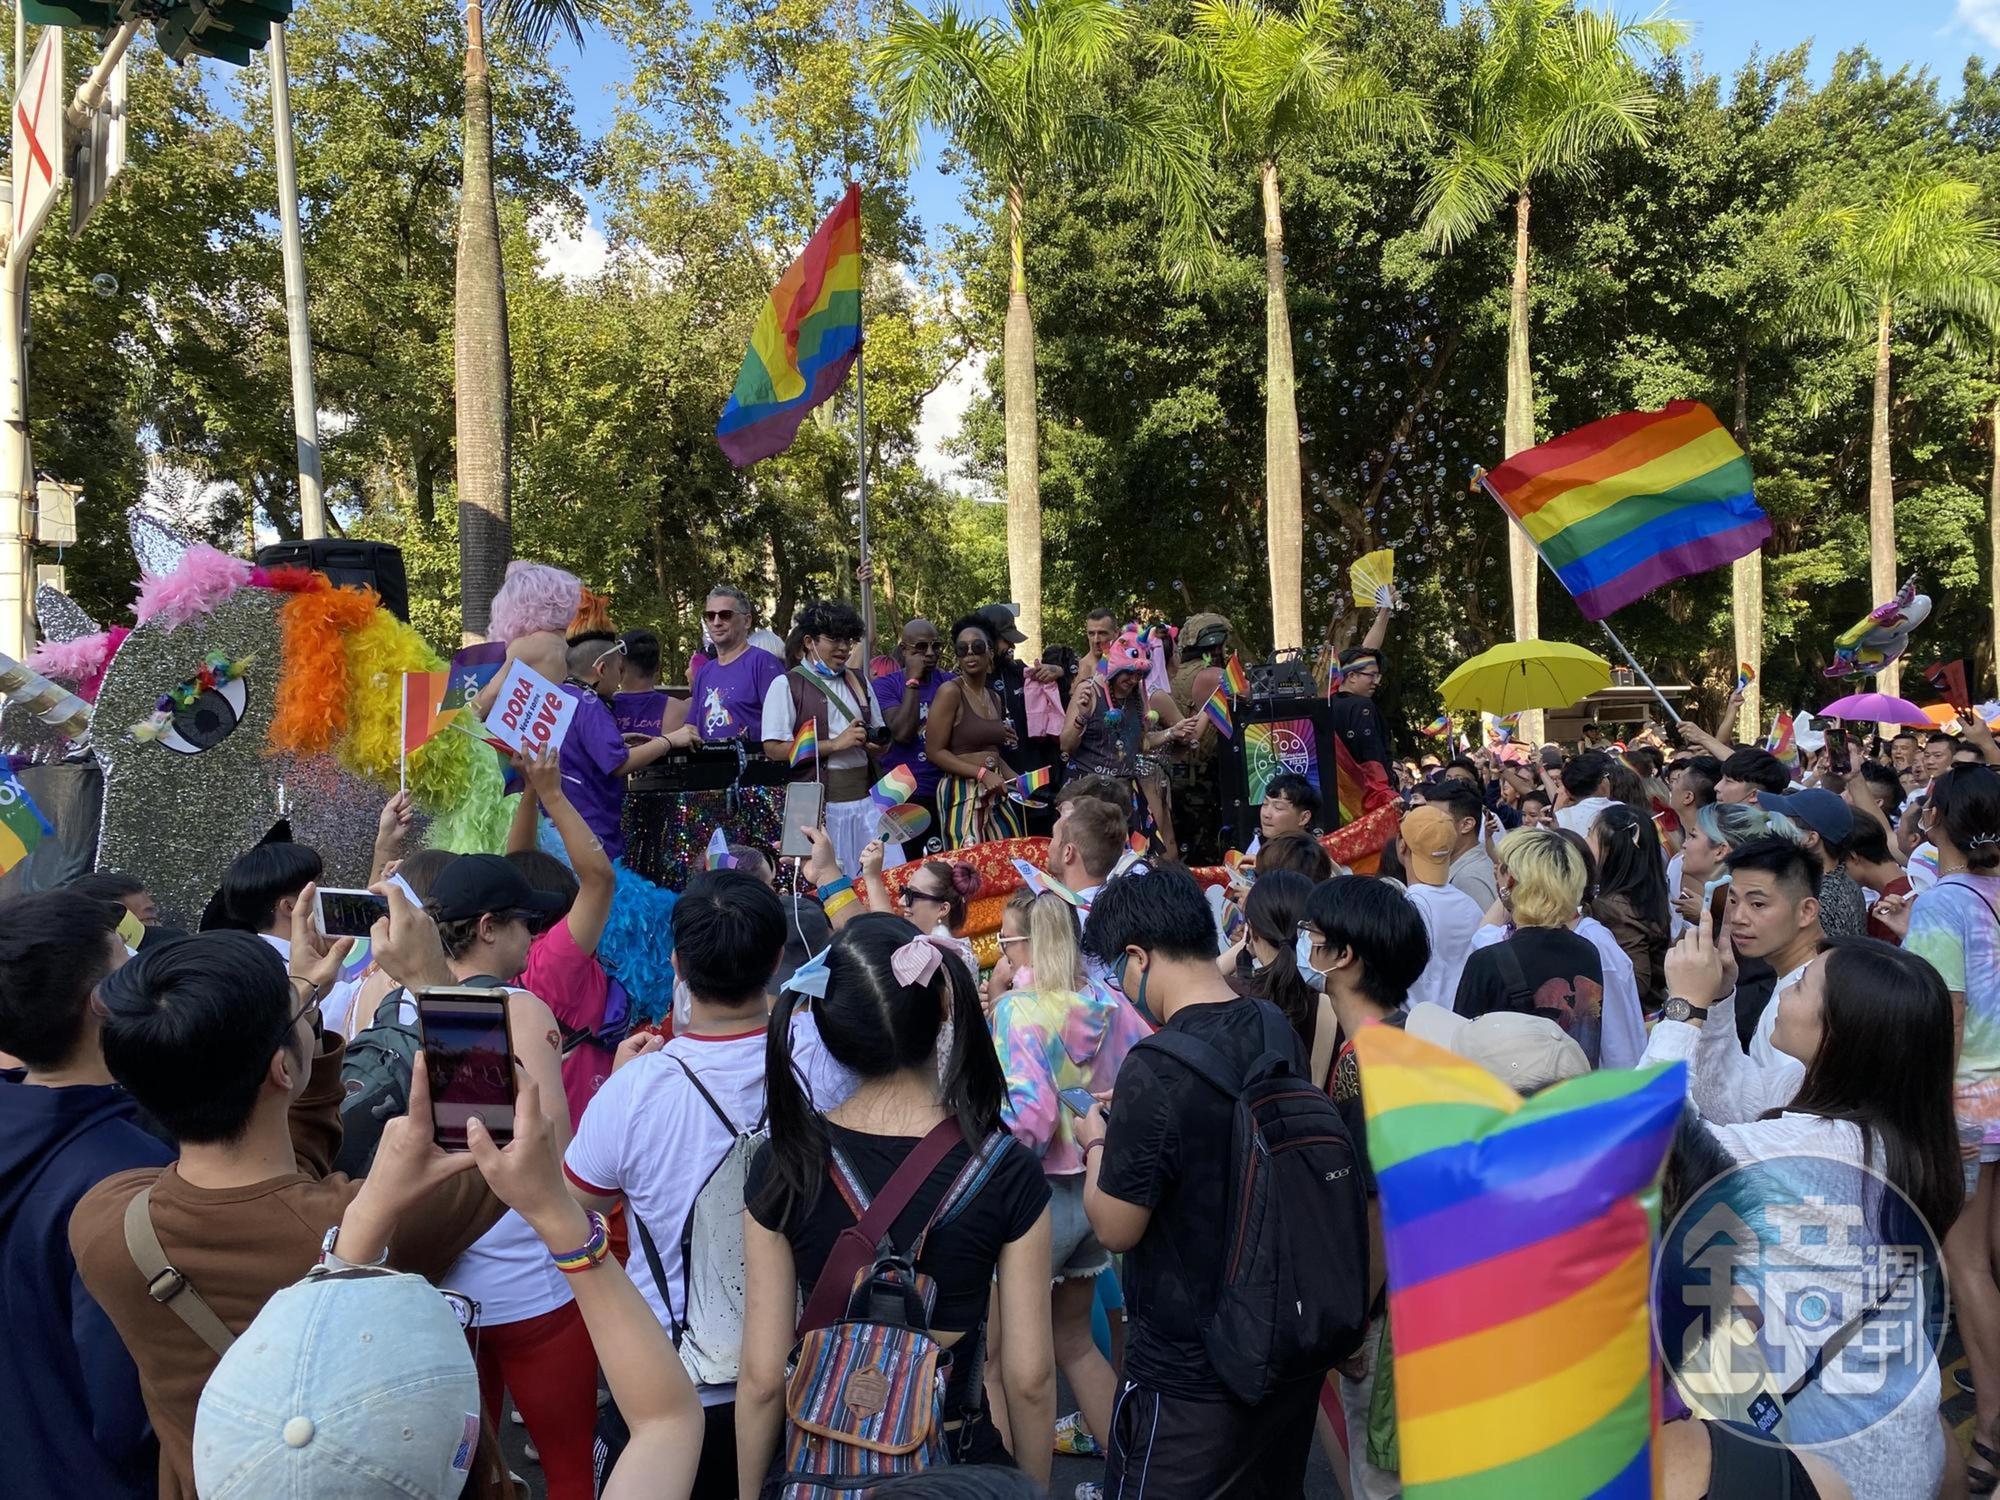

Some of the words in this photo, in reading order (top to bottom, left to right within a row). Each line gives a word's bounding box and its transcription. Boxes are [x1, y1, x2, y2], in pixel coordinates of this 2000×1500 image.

[502, 677, 534, 732] DORA
[518, 711, 534, 733] Needs
[530, 693, 541, 712] some
[1325, 1166, 1352, 1180] acer
